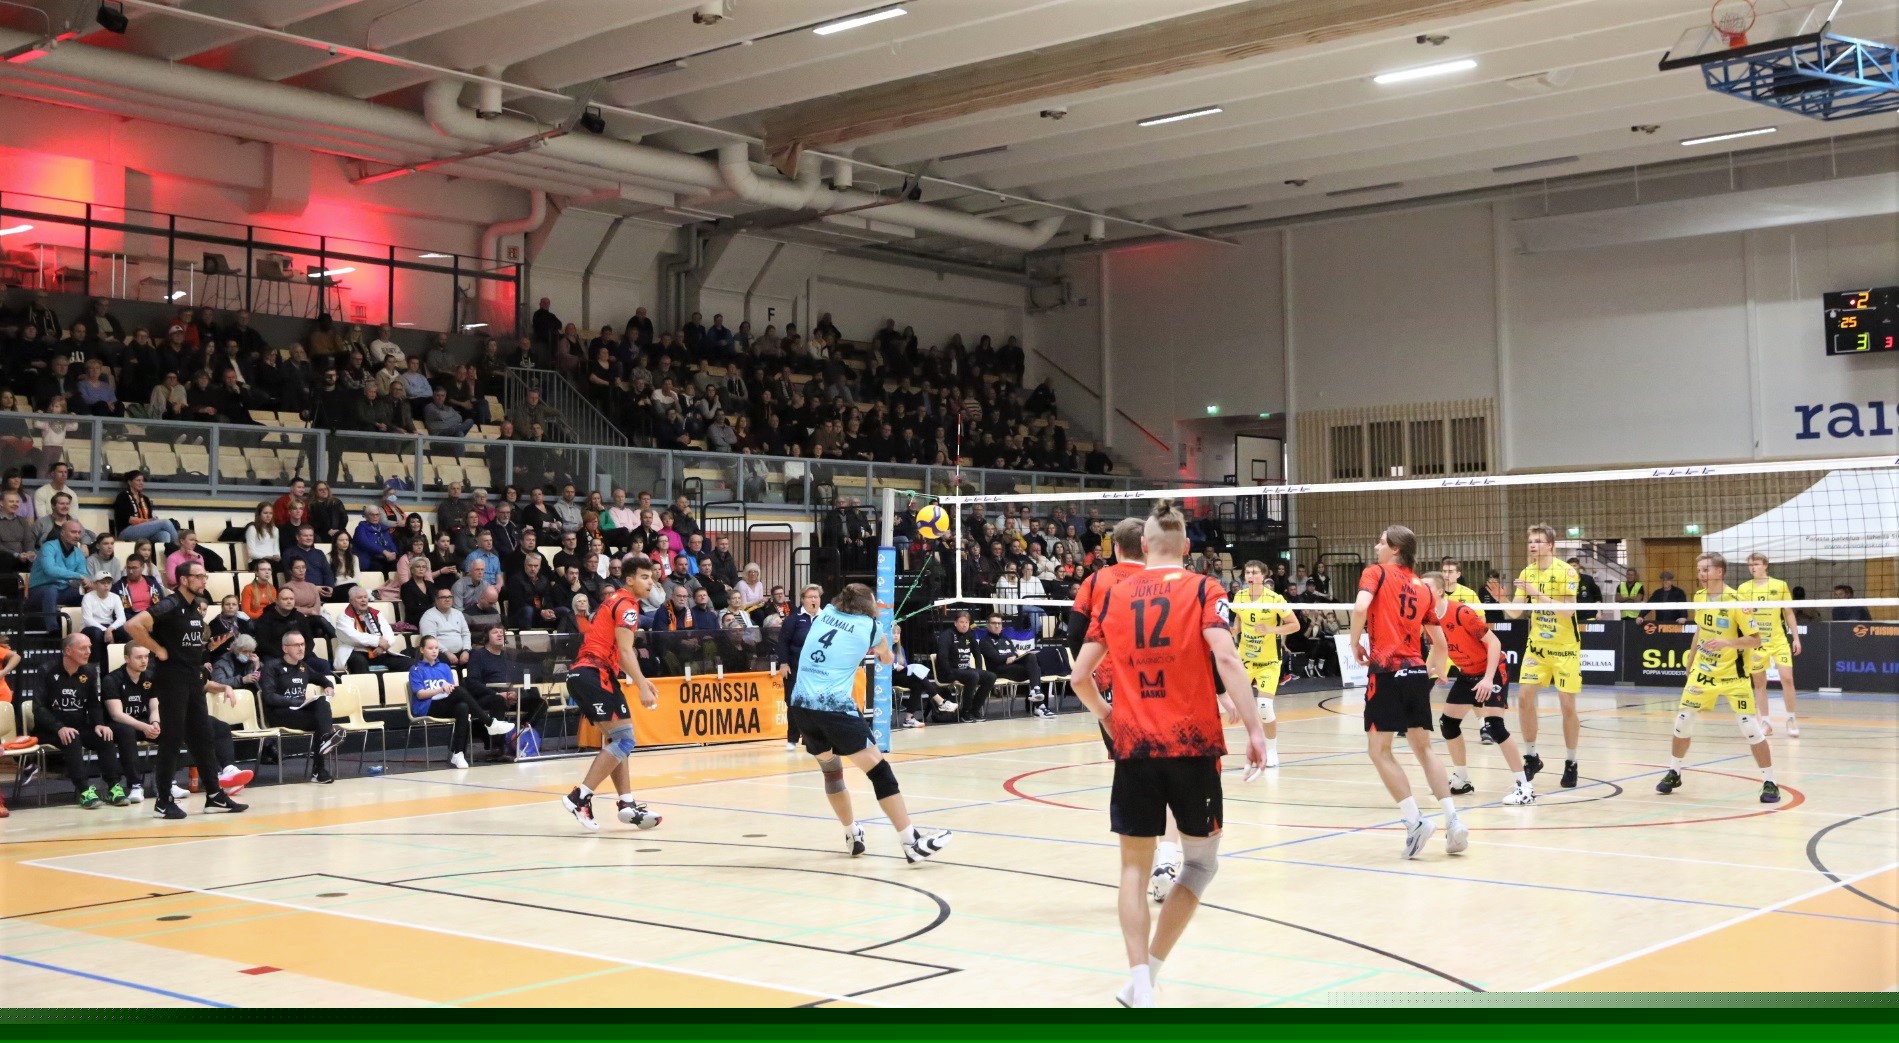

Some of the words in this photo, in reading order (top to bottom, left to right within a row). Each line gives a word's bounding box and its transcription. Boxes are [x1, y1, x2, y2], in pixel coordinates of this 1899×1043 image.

[1857, 291, 1869, 309] 2
[768, 307, 775, 321] F
[1840, 316, 1857, 328] 25
[1857, 333, 1868, 350] 3
[1885, 336, 1893, 348] 3
[1794, 401, 1899, 439] rai
[1398, 593, 1418, 620] 15
[821, 614, 855, 634] KULMALA
[1130, 597, 1171, 649] 12
[1250, 612, 1256, 623] 6
[1704, 613, 1713, 626] 19
[818, 628, 838, 649] 4
[1835, 661, 1877, 673] SILJA
[680, 682, 760, 704] ORANSSIA
[621, 704, 627, 713] 6
[1737, 700, 1747, 709] 19
[680, 707, 761, 737] VOIMAA
